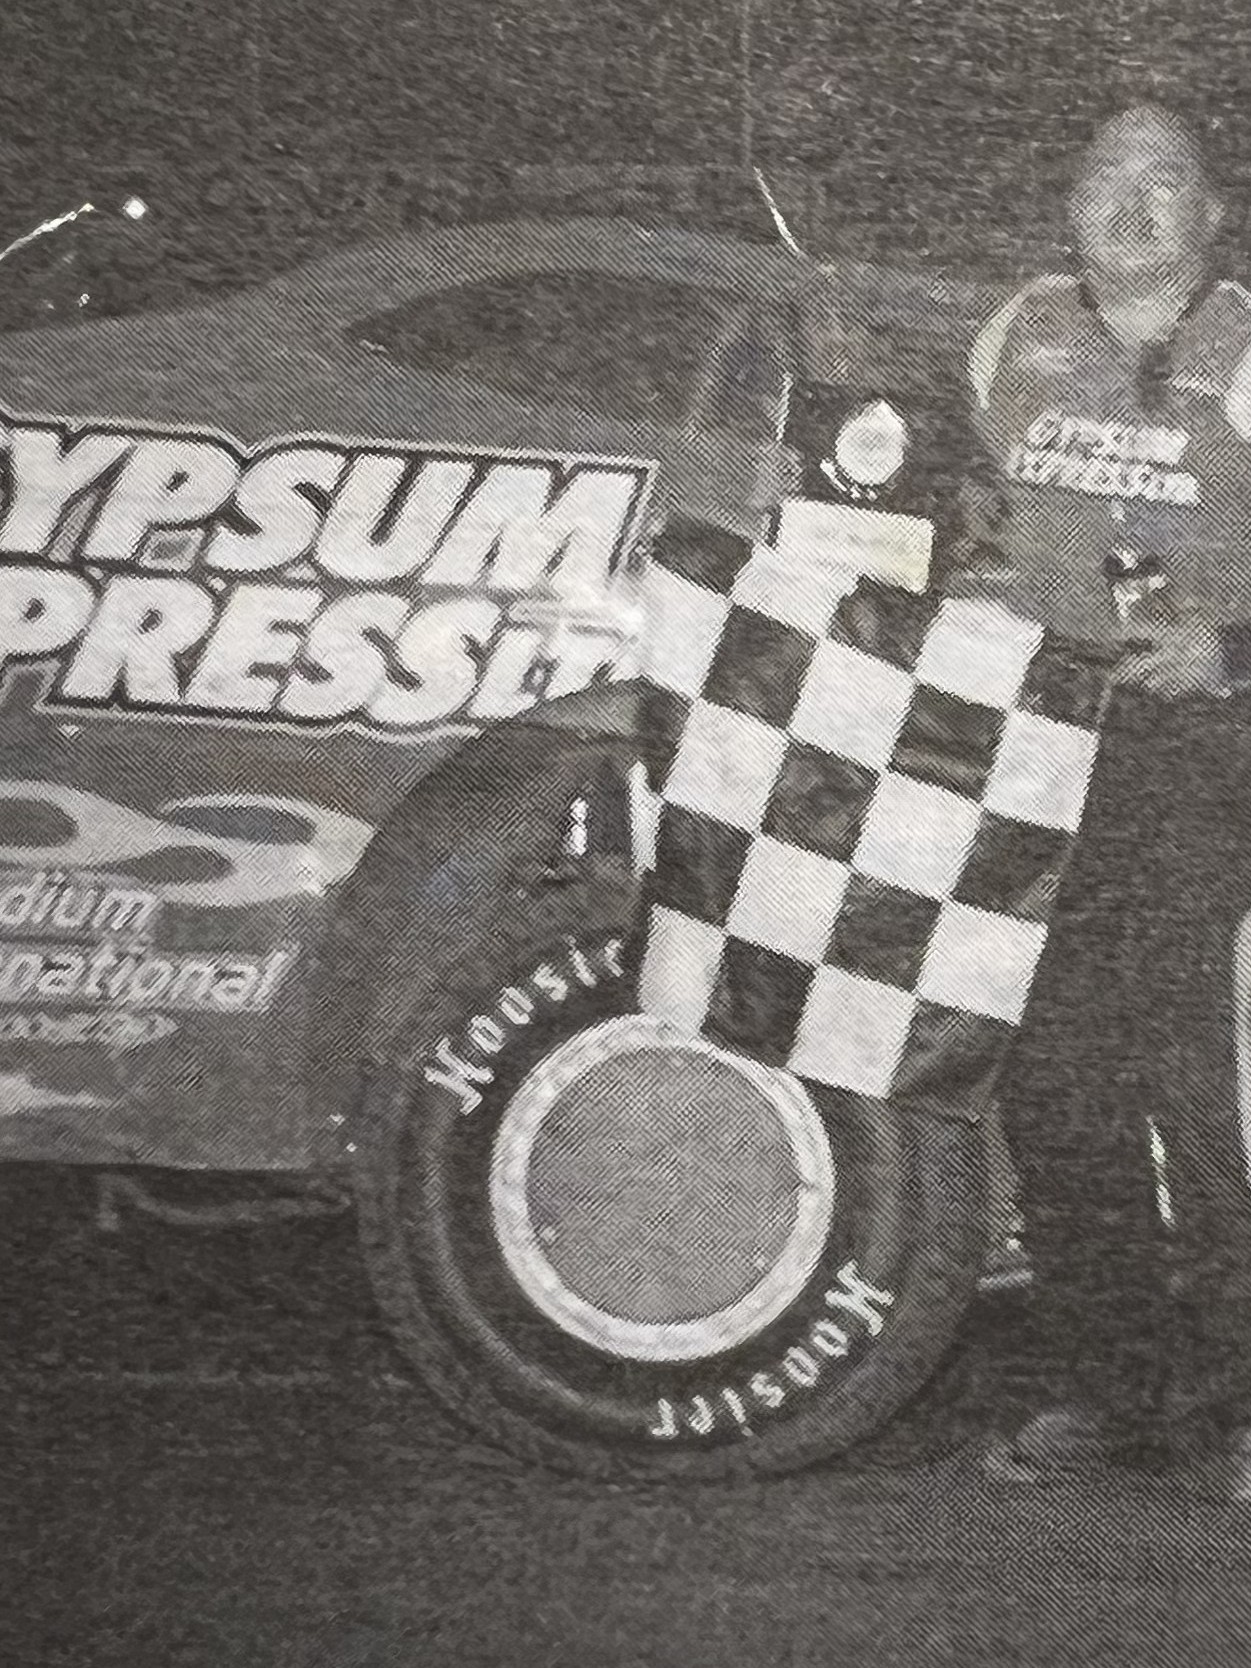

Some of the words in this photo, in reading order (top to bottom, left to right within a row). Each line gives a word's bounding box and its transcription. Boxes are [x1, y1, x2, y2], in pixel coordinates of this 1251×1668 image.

[0, 424, 642, 600] YPSUM
[423, 935, 626, 1115] Hoosie
[651, 1258, 895, 1440] Hoosier
